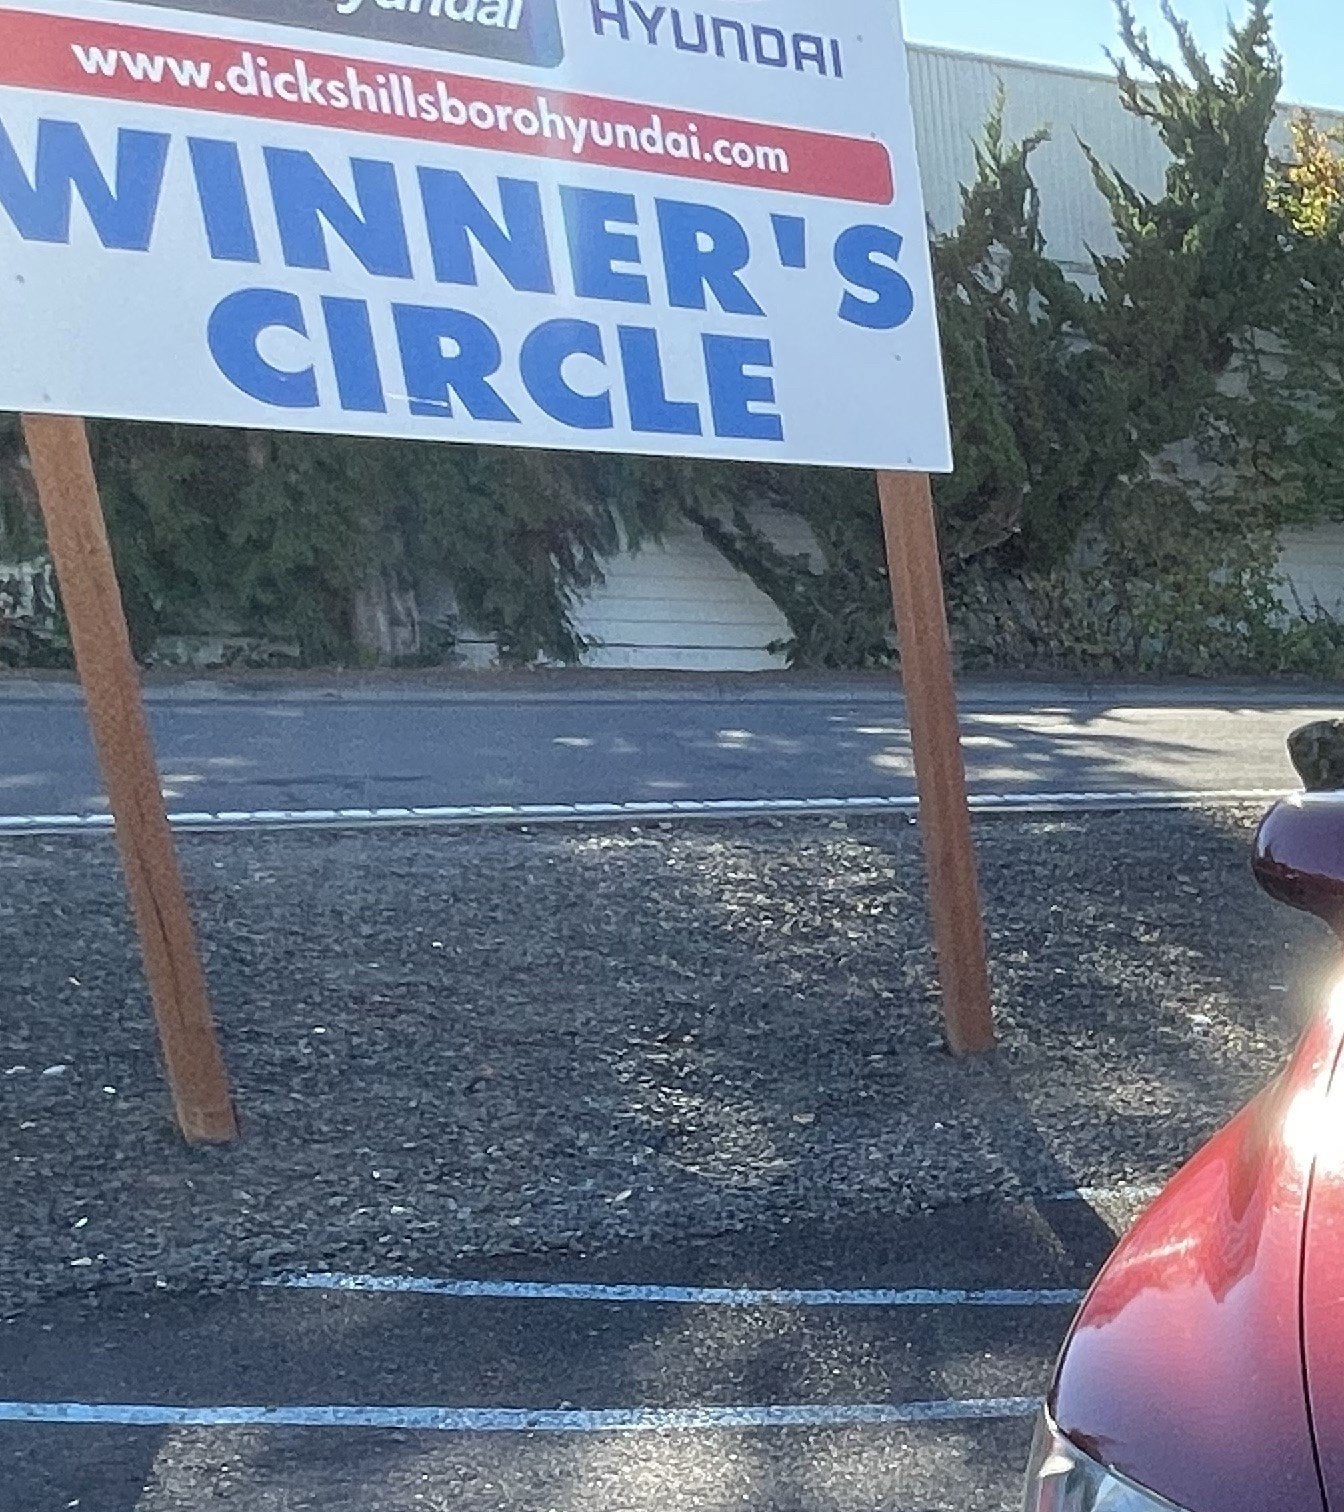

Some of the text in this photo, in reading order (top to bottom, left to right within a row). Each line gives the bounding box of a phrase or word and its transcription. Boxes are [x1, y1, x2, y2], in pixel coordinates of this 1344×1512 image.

[70, 43, 790, 174] www.dickshillsborohyundai.com
[591, 0, 844, 79] HYUNDAI
[0, 112, 915, 331] WINNER'S
[206, 287, 785, 442] CIRCLE
